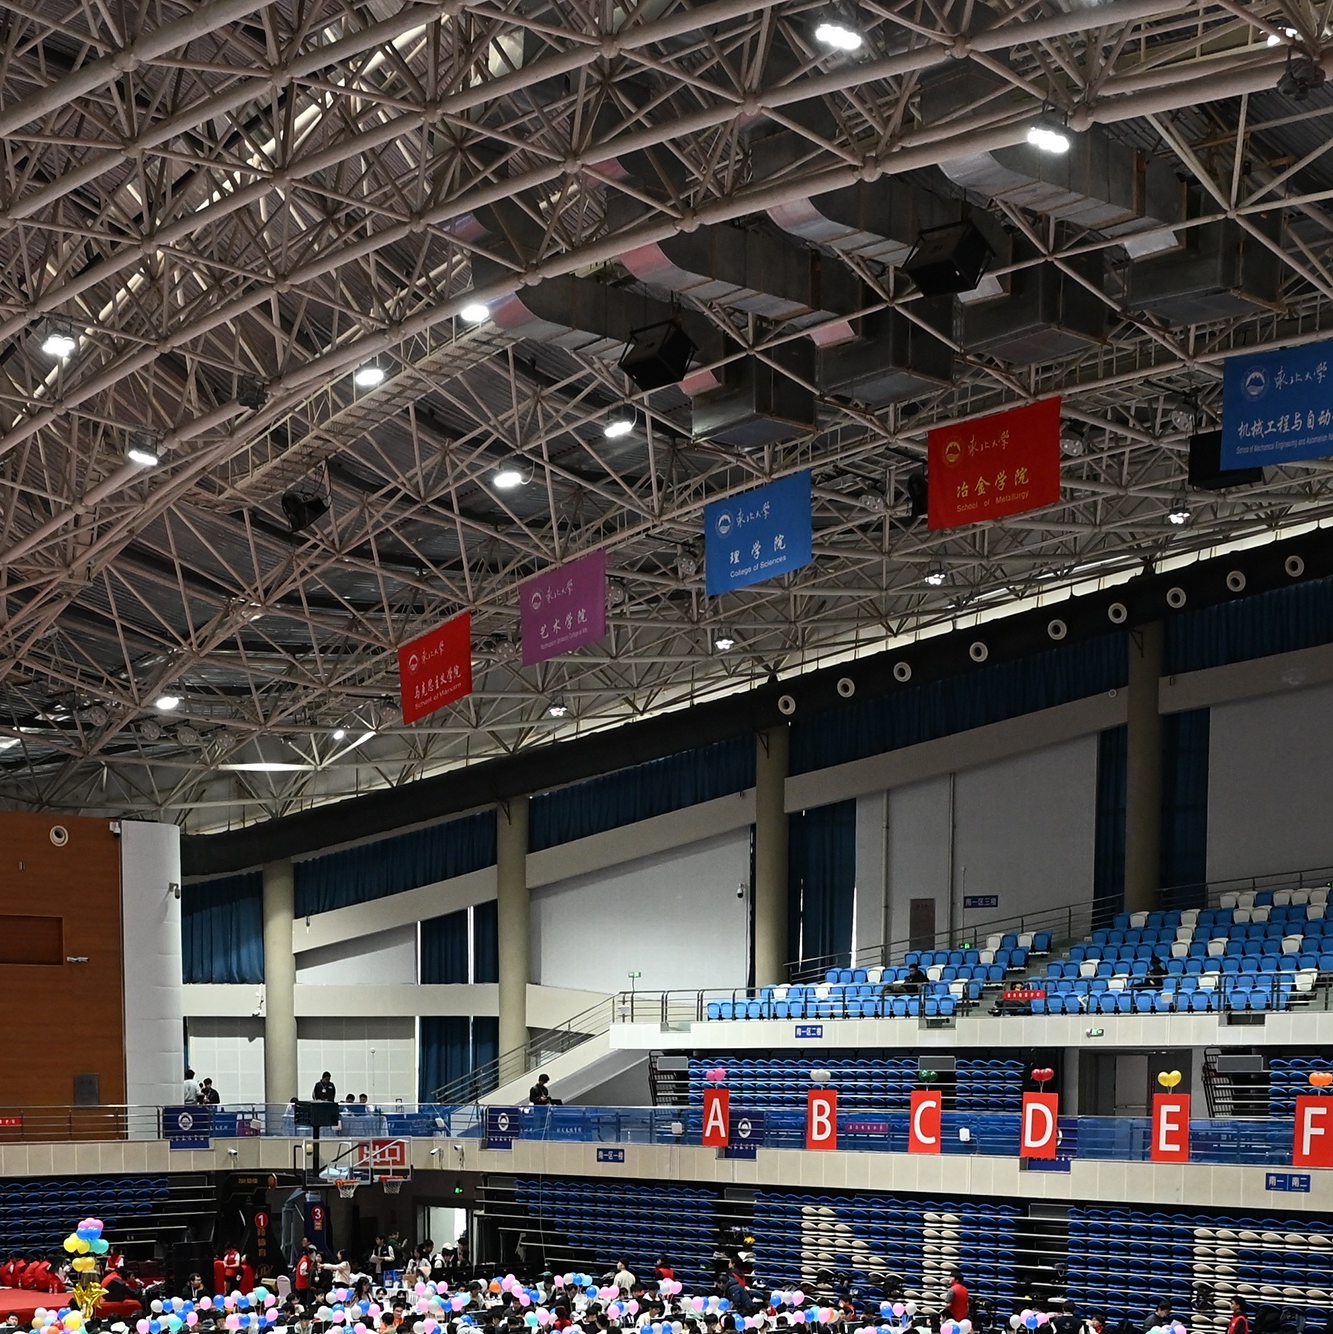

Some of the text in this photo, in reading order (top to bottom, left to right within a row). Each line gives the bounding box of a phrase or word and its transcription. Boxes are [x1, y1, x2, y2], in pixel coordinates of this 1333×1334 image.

[957, 467, 1030, 499] 冶金学院
[957, 490, 1030, 513] School of Metallurgy
[730, 566, 752, 579] College
[760, 554, 787, 570] Sciences
[539, 608, 588, 639] 艺术学院
[415, 697, 431, 710] School
[706, 1098, 726, 1138] A
[811, 1099, 832, 1141] B
[915, 1100, 936, 1144] C
[1024, 1102, 1053, 1148] D
[1160, 1104, 1181, 1152] E
[1302, 1106, 1327, 1156] F
[1268, 1175, 1308, 1187] 南一 南二
[259, 1214, 264, 1227] 1
[314, 1208, 321, 1220] 3
